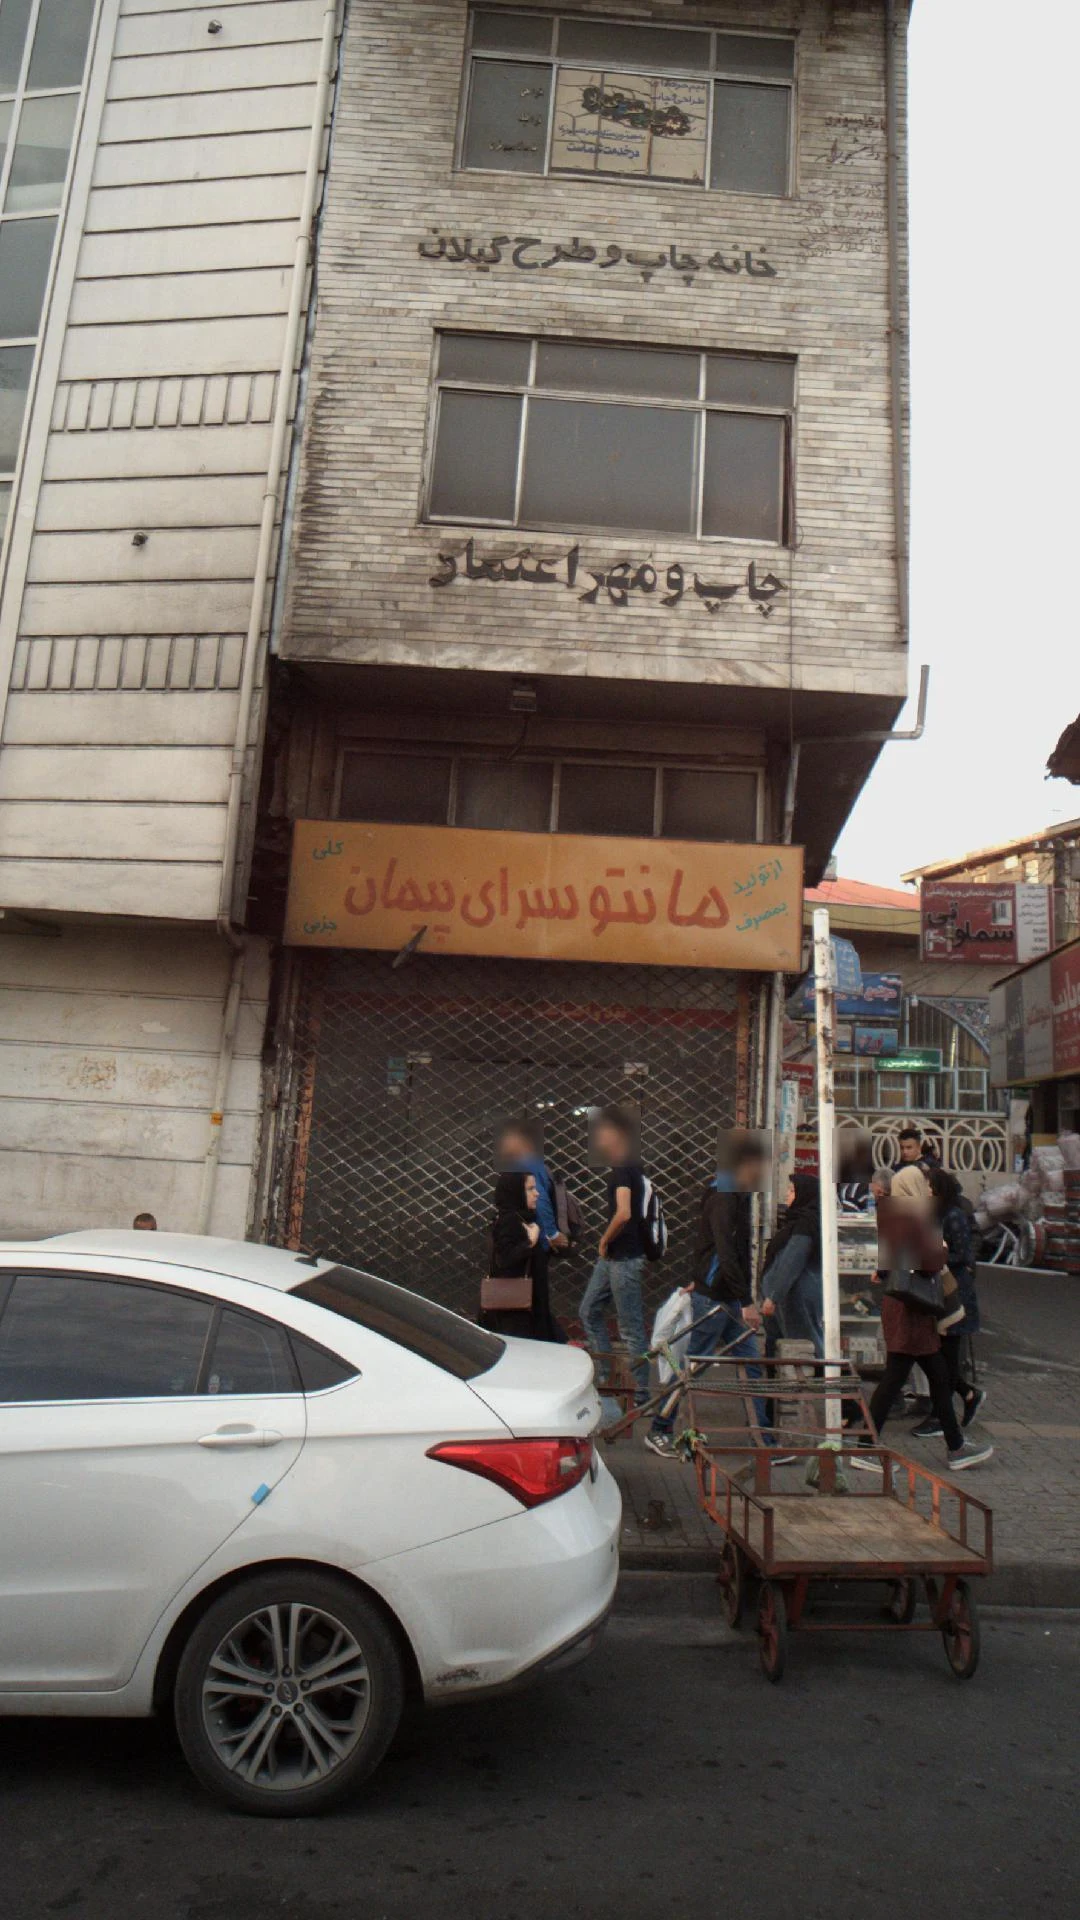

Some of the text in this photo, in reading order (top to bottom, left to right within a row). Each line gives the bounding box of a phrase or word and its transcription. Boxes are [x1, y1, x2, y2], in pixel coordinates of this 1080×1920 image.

[511, 236, 597, 270] طرح
[598, 243, 622, 269] و
[626, 244, 701, 287] چاپ
[707, 243, 778, 278] خانه
[576, 552, 660, 608] مهر
[659, 561, 685, 608] و
[691, 559, 790, 620] چاپ
[312, 839, 345, 862] کلی
[342, 856, 457, 945] پیمان
